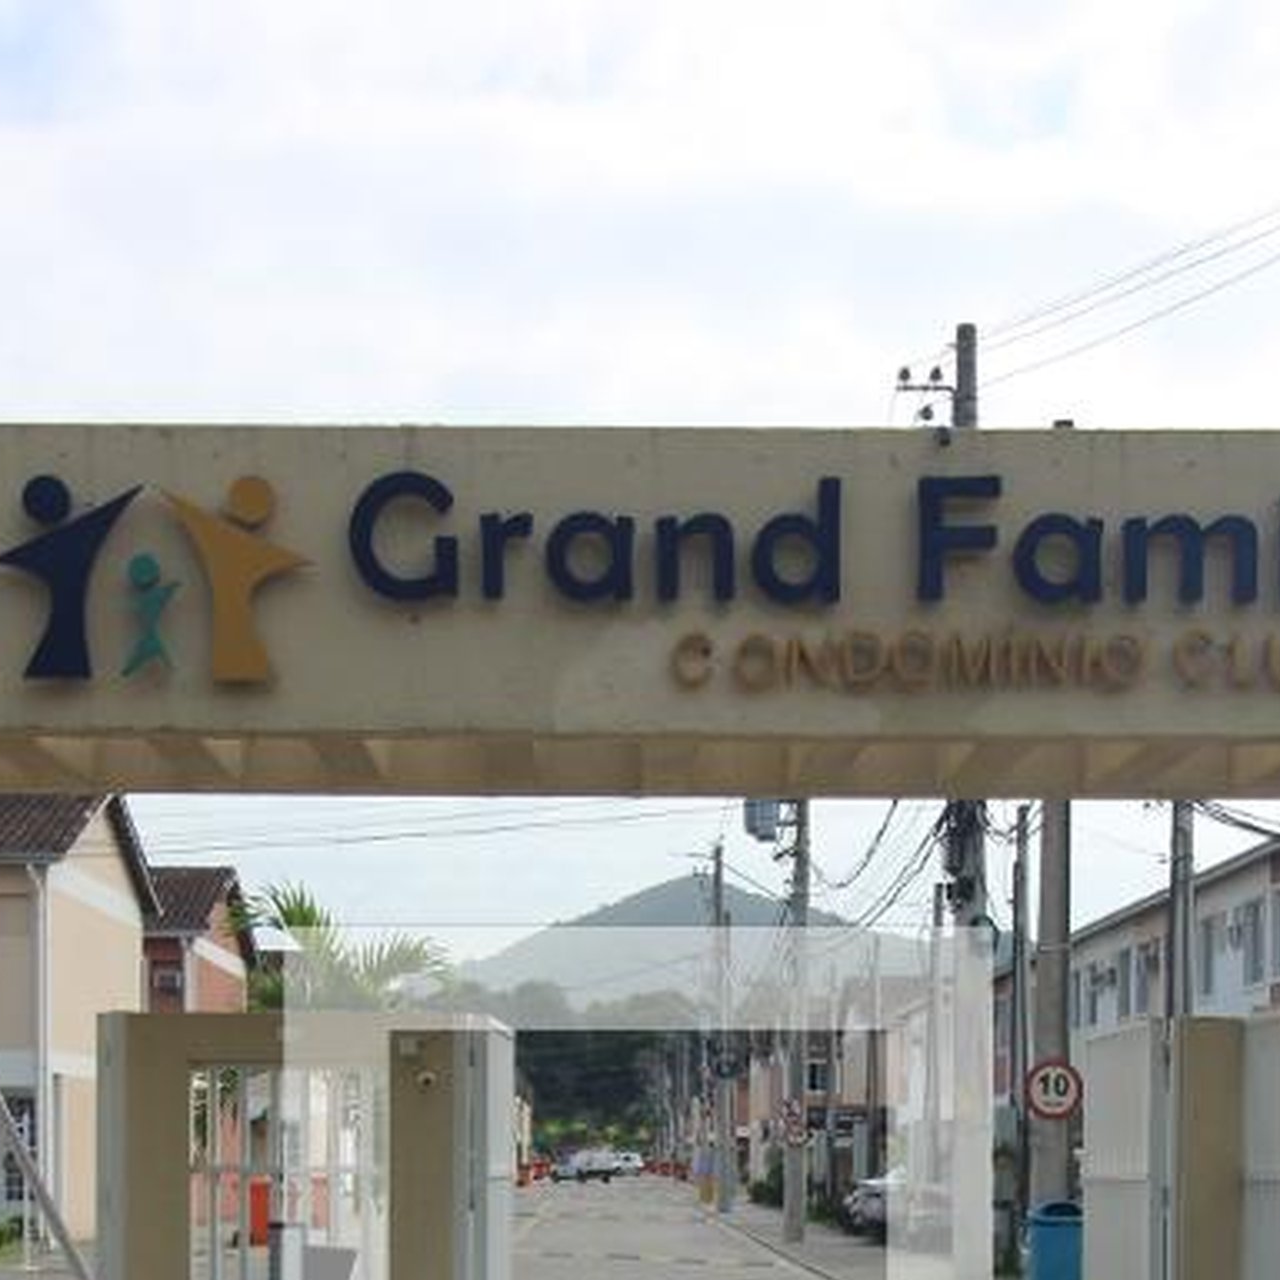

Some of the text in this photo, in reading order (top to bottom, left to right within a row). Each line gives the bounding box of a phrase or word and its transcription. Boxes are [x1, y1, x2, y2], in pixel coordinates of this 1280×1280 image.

[348, 470, 842, 605] Grand
[671, 624, 1147, 693] CONDOMÍNIO
[1039, 1073, 1070, 1097] 10
